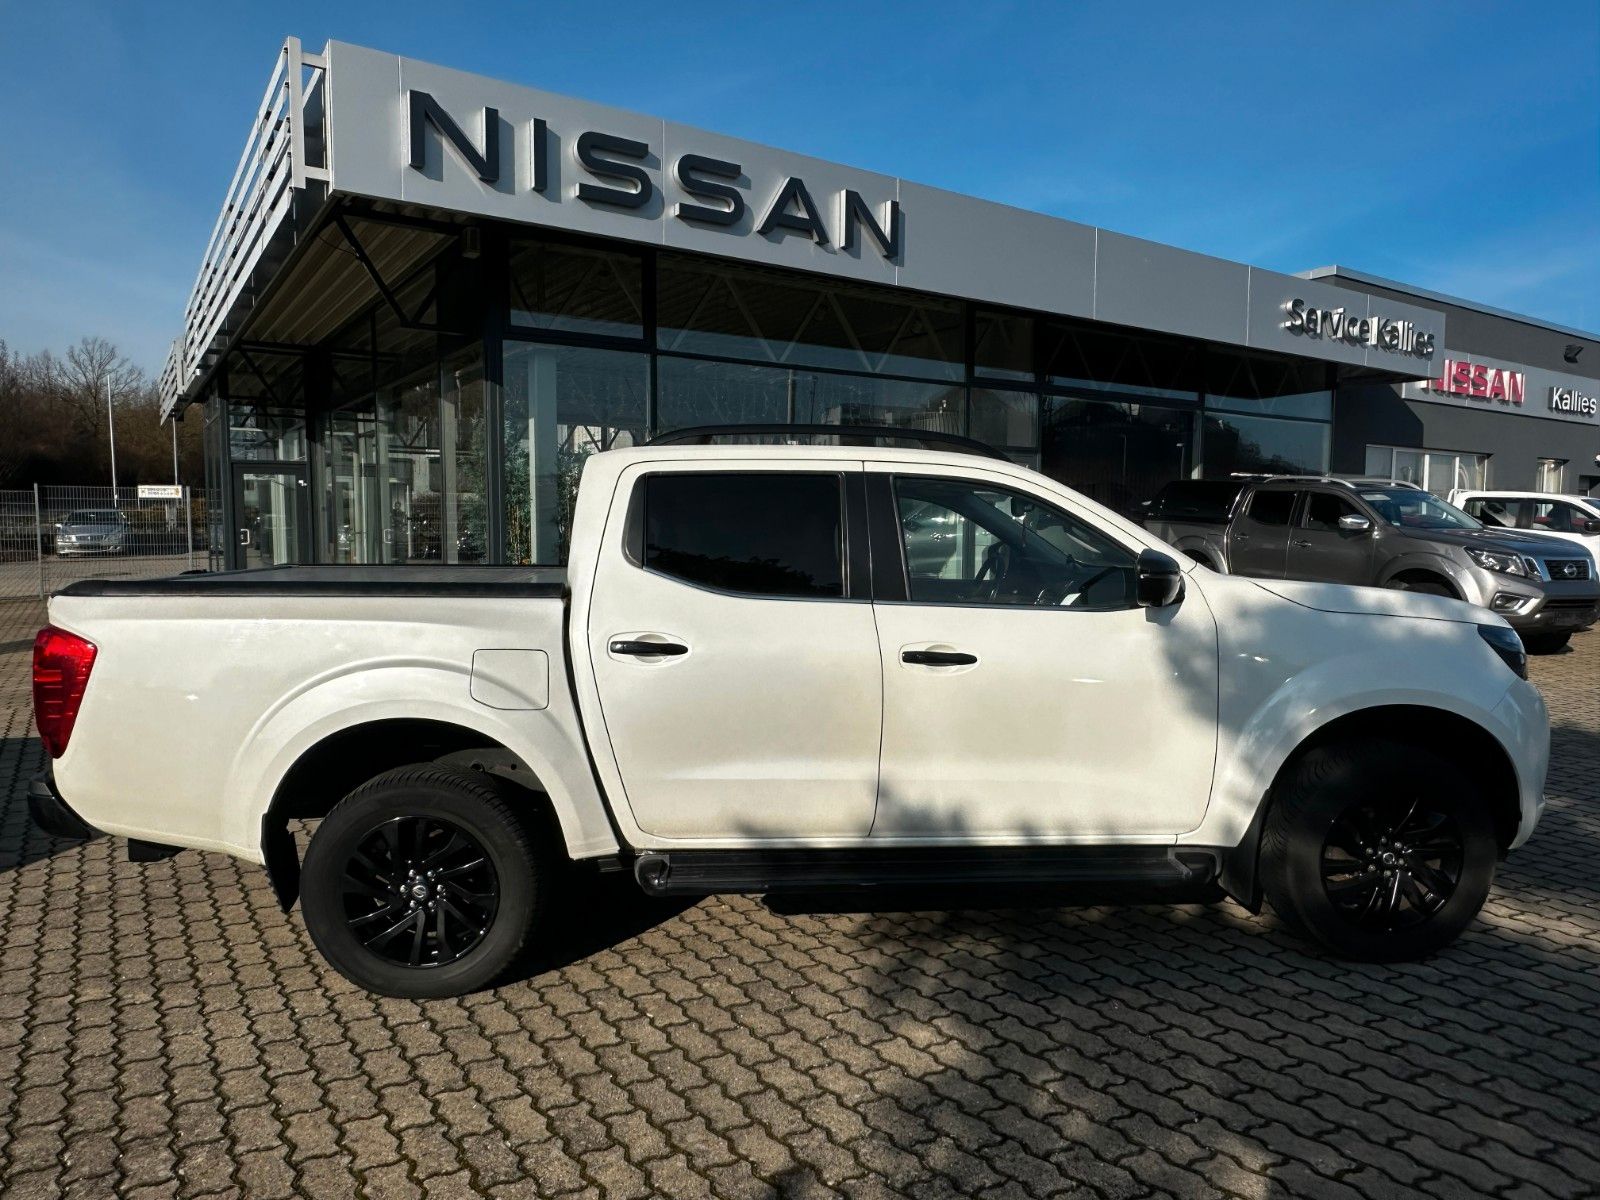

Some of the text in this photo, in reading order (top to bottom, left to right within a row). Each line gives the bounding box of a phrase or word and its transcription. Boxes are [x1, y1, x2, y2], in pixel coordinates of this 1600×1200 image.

[408, 89, 900, 258] NISSAN
[1282, 298, 1436, 356] Service Kallies
[1551, 386, 1597, 414] Kallies
